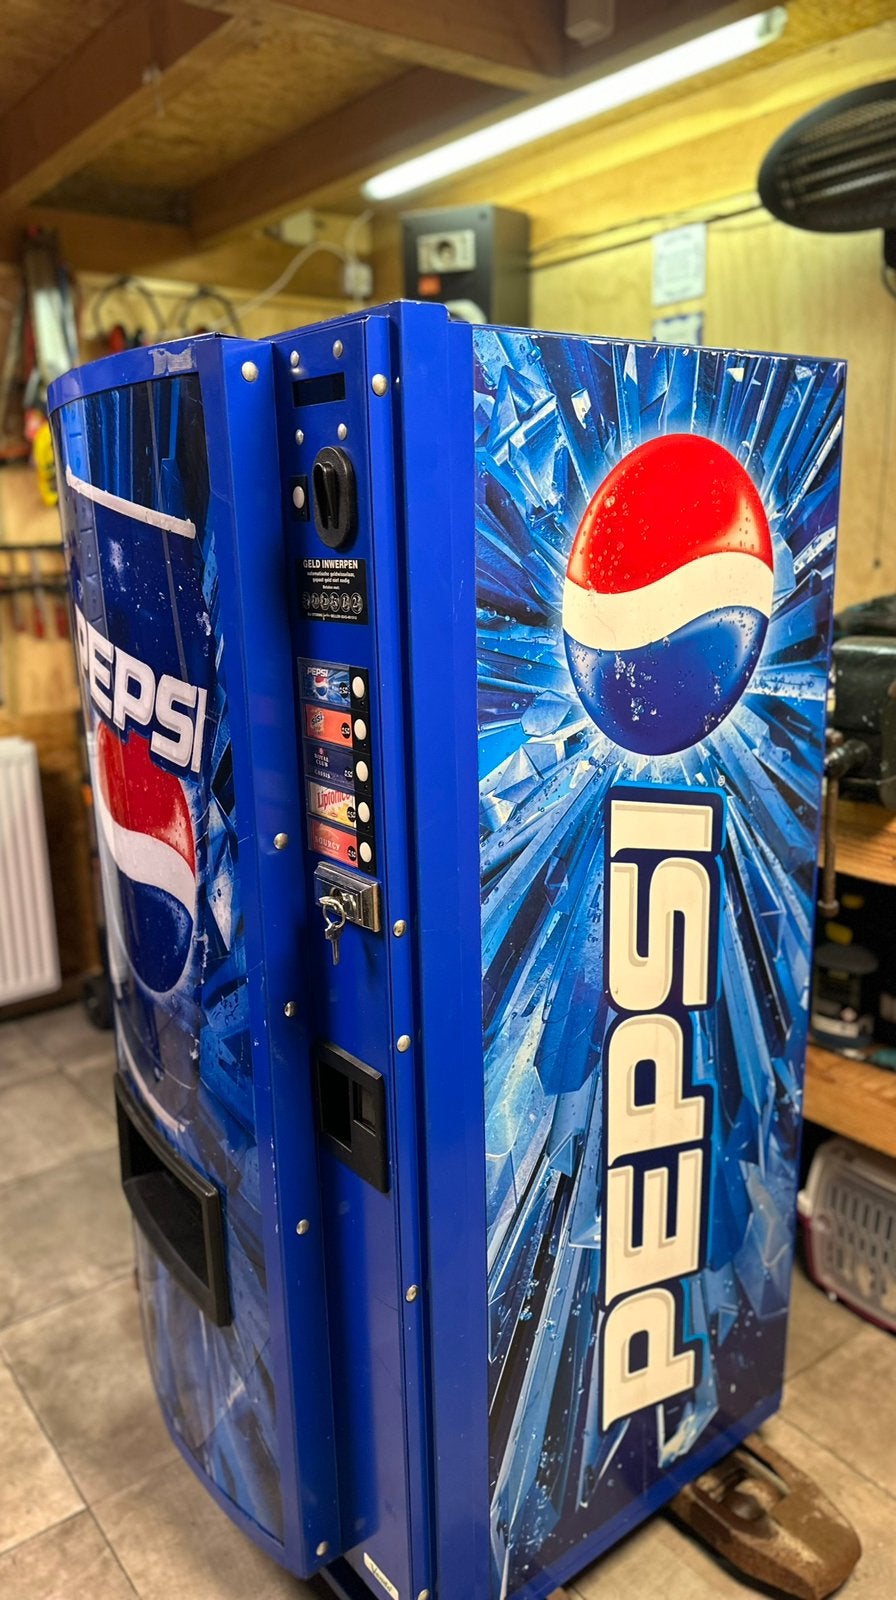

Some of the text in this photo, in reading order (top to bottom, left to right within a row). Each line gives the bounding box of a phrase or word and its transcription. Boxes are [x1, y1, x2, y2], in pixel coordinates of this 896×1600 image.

[303, 560, 359, 570] GELD INWERPEN
[75, 603, 208, 774] PEPSI
[306, 666, 329, 678] PEPSI
[602, 799, 713, 1432] PEPSI
